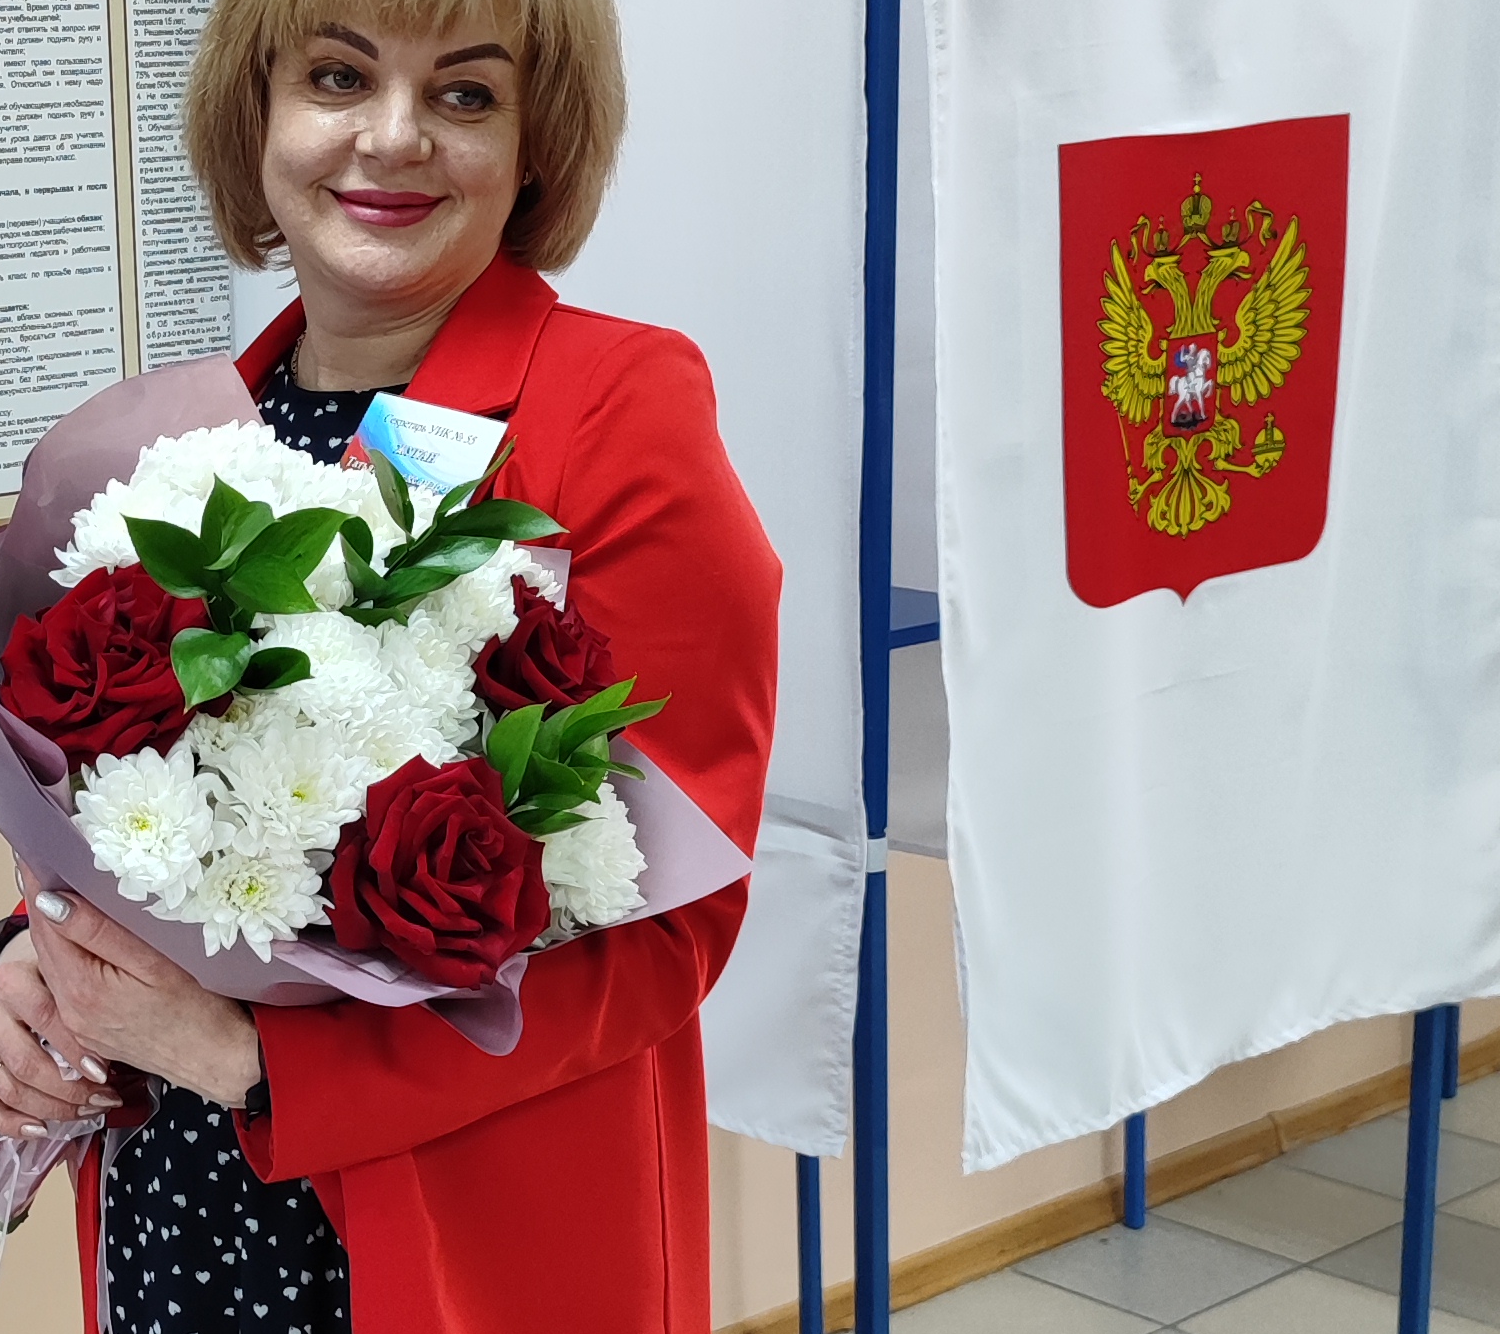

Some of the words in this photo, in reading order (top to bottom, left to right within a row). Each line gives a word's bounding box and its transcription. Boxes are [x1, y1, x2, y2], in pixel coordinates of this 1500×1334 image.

[383, 412, 427, 434] Секретарь
[427, 424, 454, 440] УИК
[466, 434, 478, 445] 55
